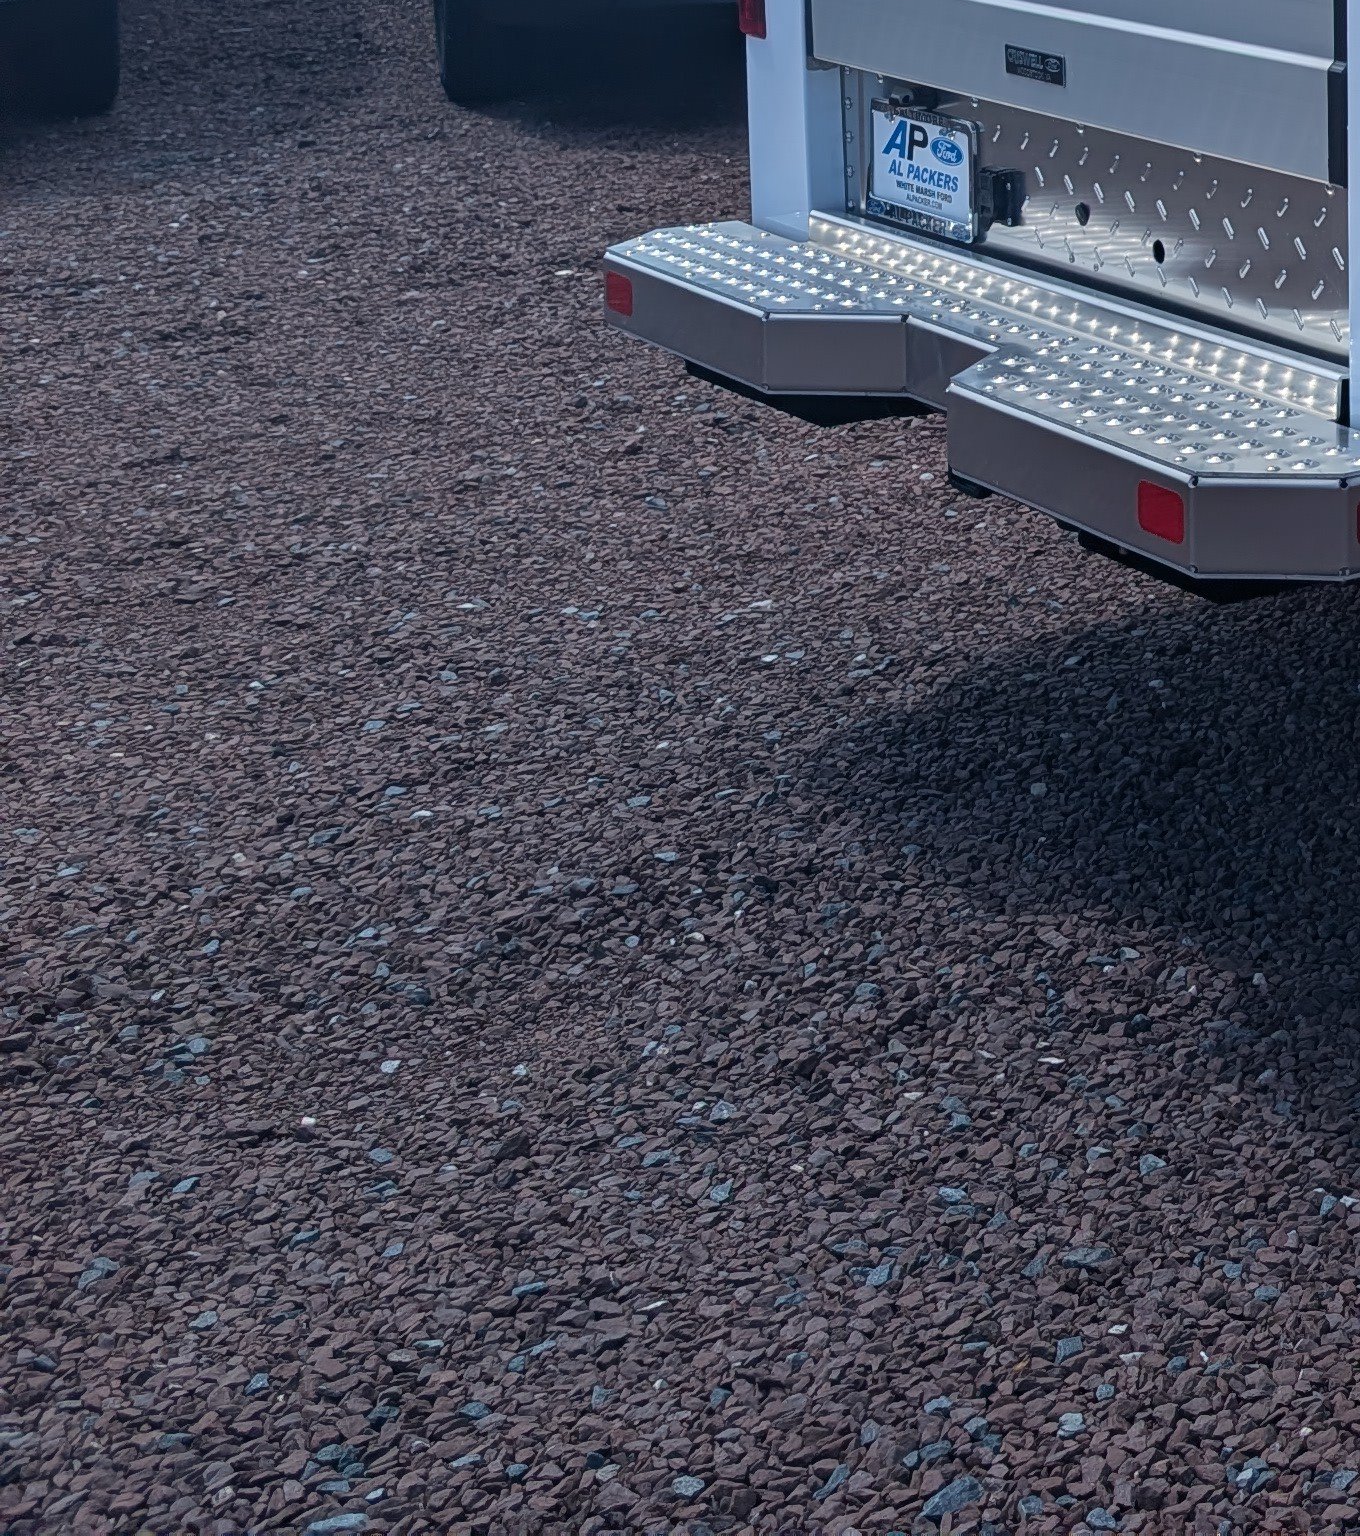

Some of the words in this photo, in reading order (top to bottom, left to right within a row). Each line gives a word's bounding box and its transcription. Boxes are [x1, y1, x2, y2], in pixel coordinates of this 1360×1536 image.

[882, 119, 929, 161] AP
[934, 139, 961, 164] Ford
[888, 159, 903, 178] AL
[906, 165, 959, 193] PACKERS
[896, 178, 915, 193] WHITE
[915, 184, 936, 199] MARSH
[936, 189, 953, 204] FORD
